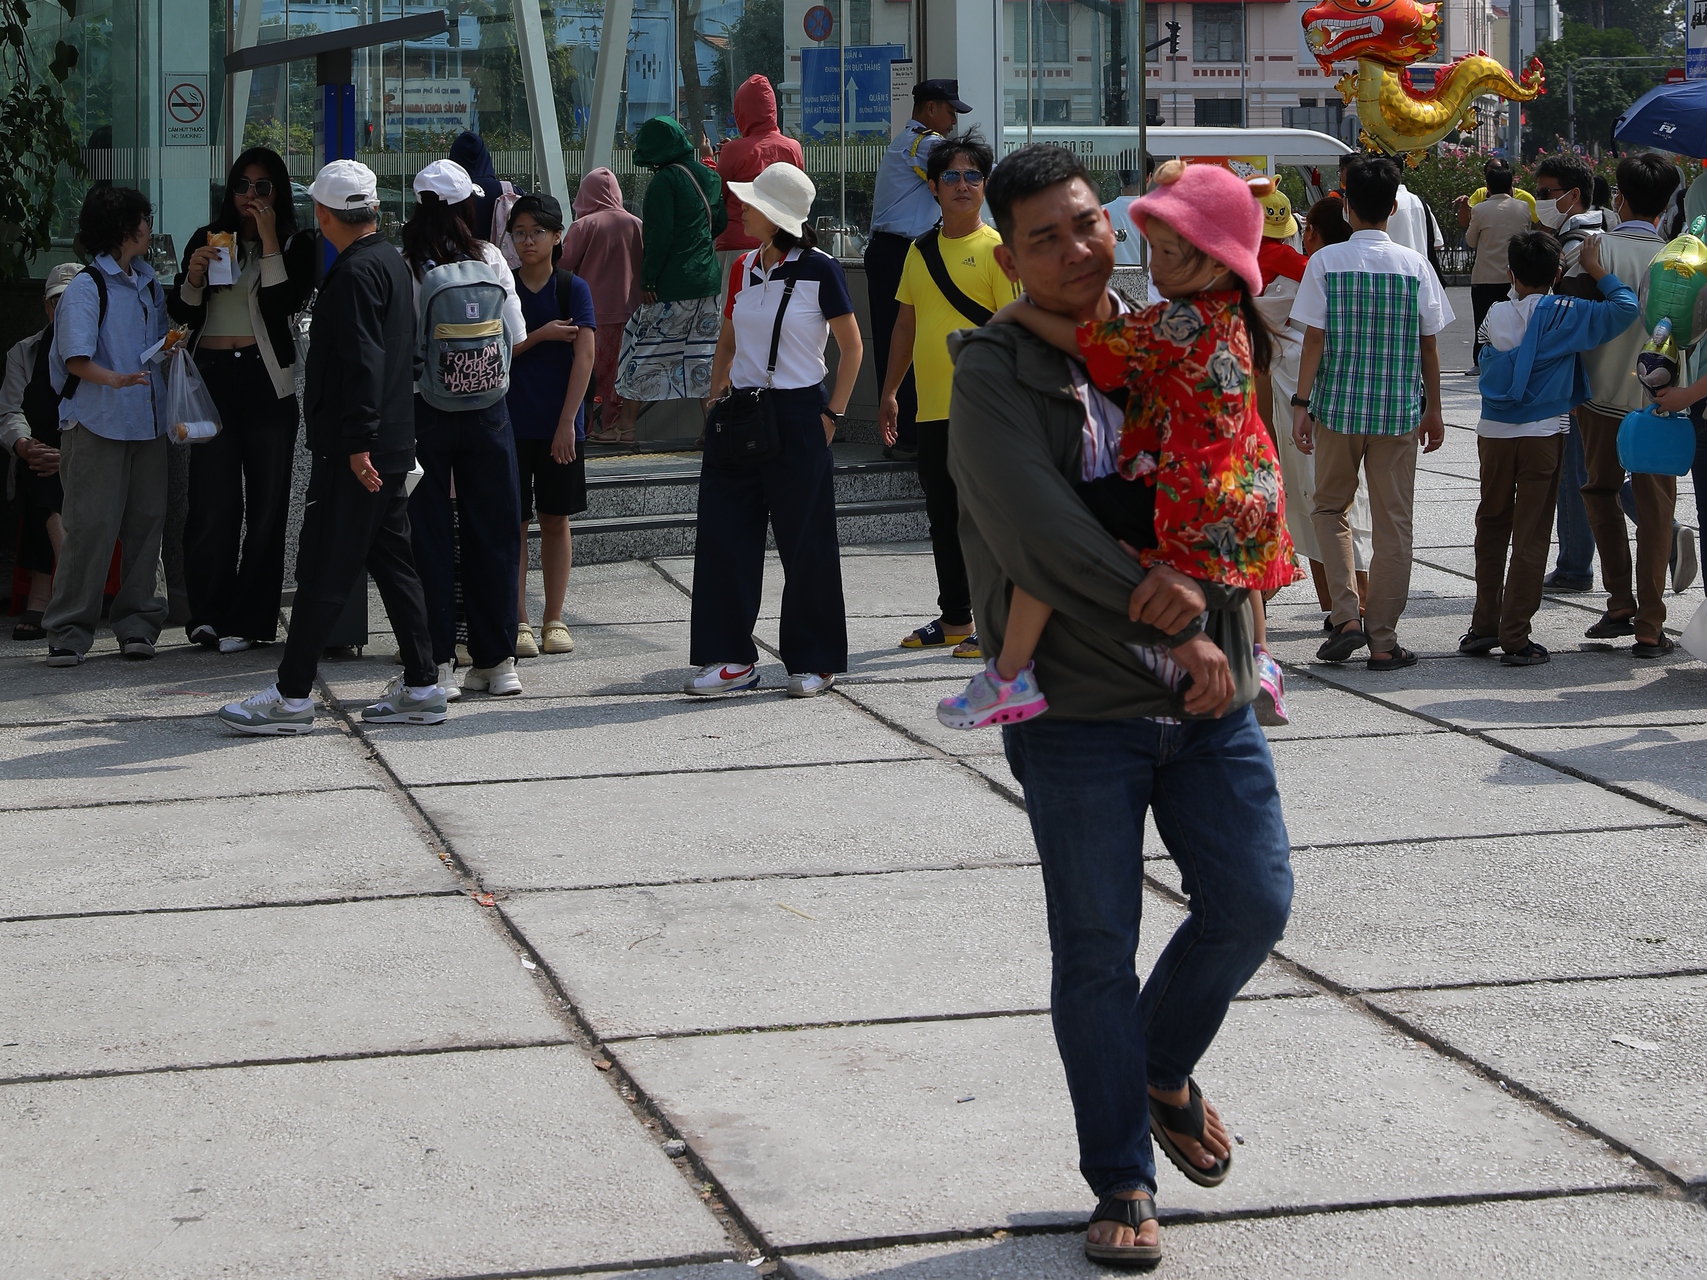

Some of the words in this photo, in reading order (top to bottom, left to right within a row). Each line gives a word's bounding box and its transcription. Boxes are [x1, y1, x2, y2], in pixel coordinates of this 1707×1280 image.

[446, 341, 498, 365] FOLLOW
[444, 361, 500, 384] WILDEST
[453, 358, 490, 374] YOUR
[451, 373, 504, 393] DREAMS
